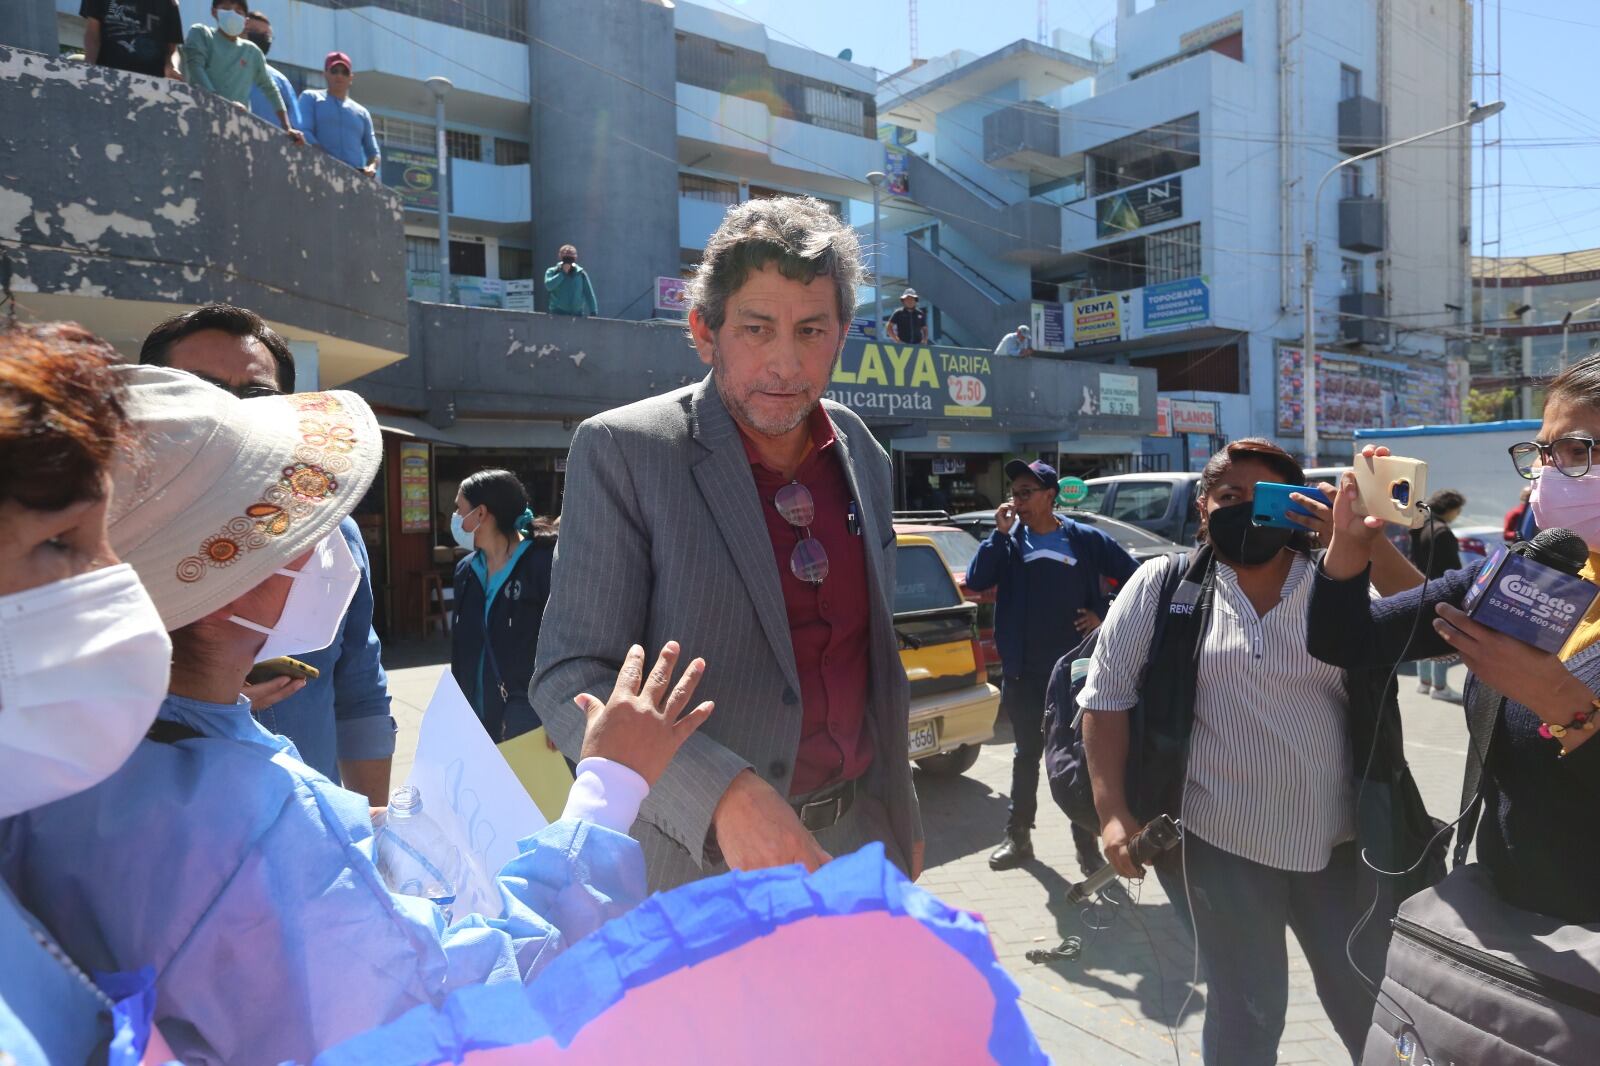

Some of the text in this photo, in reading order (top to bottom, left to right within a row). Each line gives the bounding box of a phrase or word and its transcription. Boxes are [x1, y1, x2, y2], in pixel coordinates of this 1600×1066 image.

[1077, 300, 1114, 315] VENTA
[832, 343, 940, 388] LAYA
[940, 353, 991, 375] TARIFA
[956, 379, 981, 401] 2.50
[1173, 410, 1213, 425] PLANOS
[1500, 574, 1576, 613] Contacto
[1488, 598, 1509, 611] 93.9
[1509, 606, 1525, 617] FM
[1530, 615, 1549, 627] 800
[1549, 622, 1566, 634] AM
[1531, 604, 1572, 621] Sur
